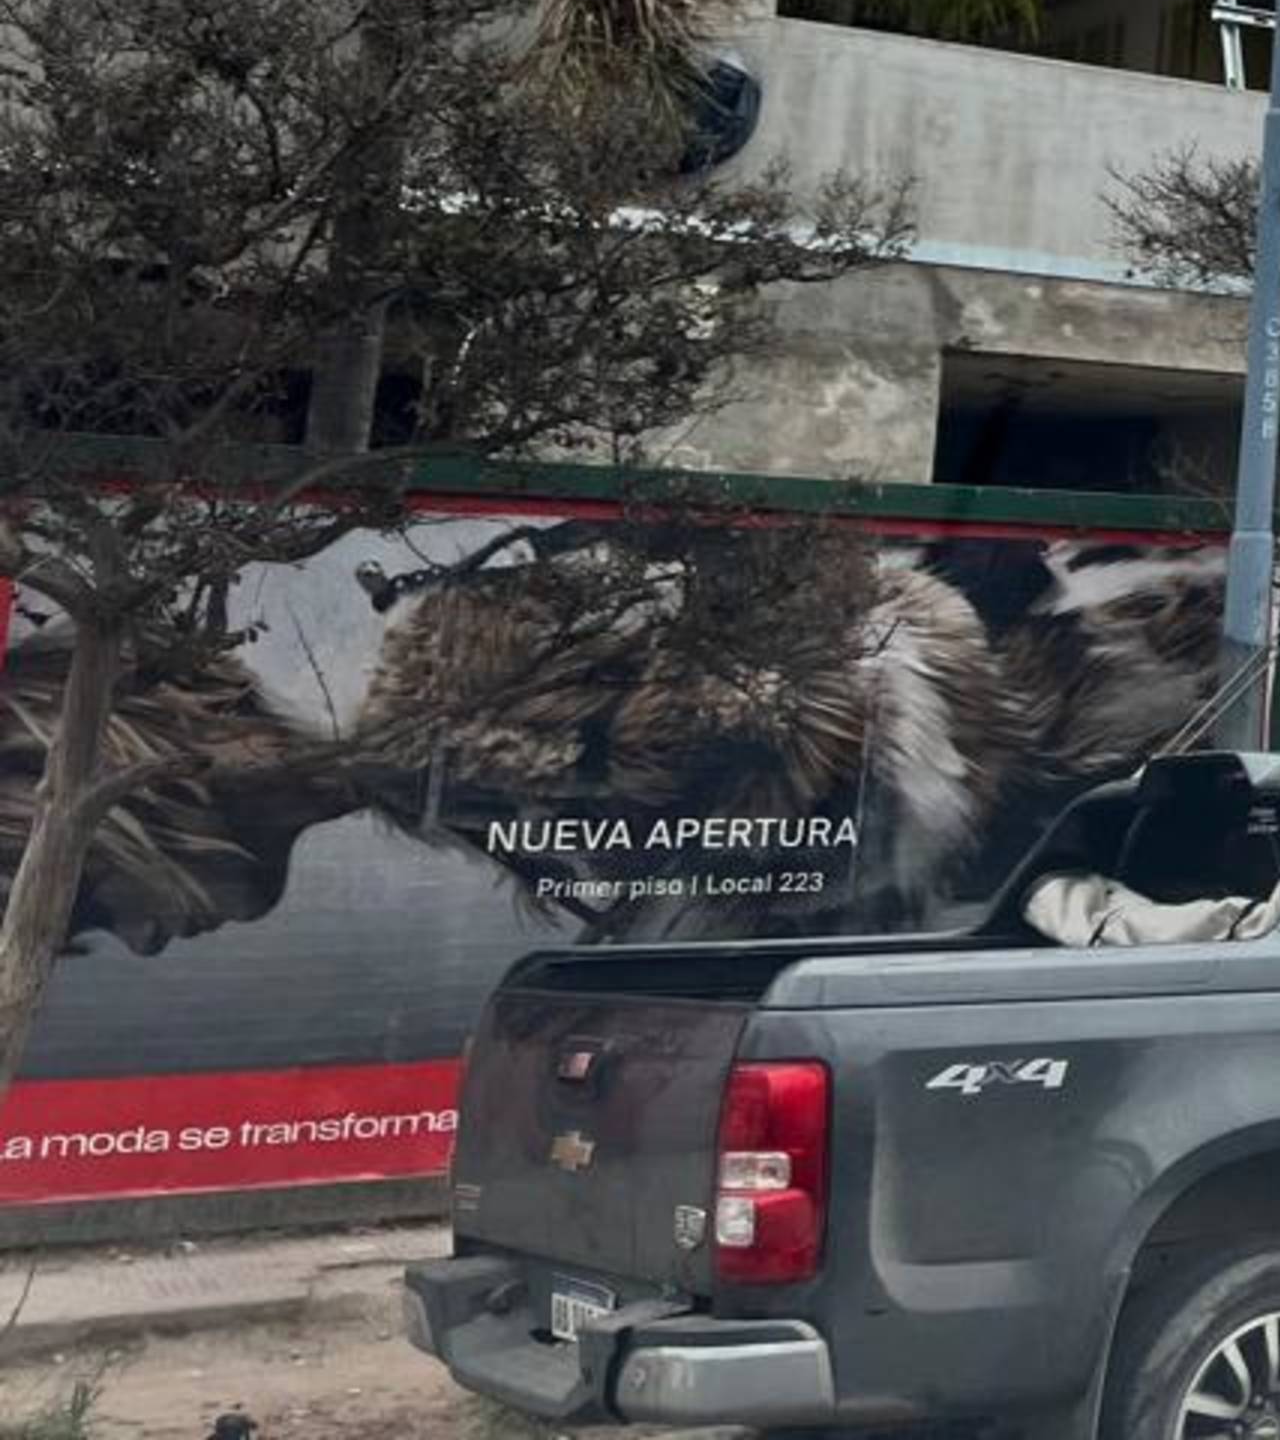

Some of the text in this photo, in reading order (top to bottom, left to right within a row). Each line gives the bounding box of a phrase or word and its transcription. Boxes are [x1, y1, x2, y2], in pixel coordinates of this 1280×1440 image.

[488, 816, 859, 853] NUEVA APERTURA
[536, 871, 824, 901] Primer piso Local 223
[40, 1126, 169, 1160] moda
[178, 1122, 231, 1151] se
[240, 1108, 459, 1147] transforma
